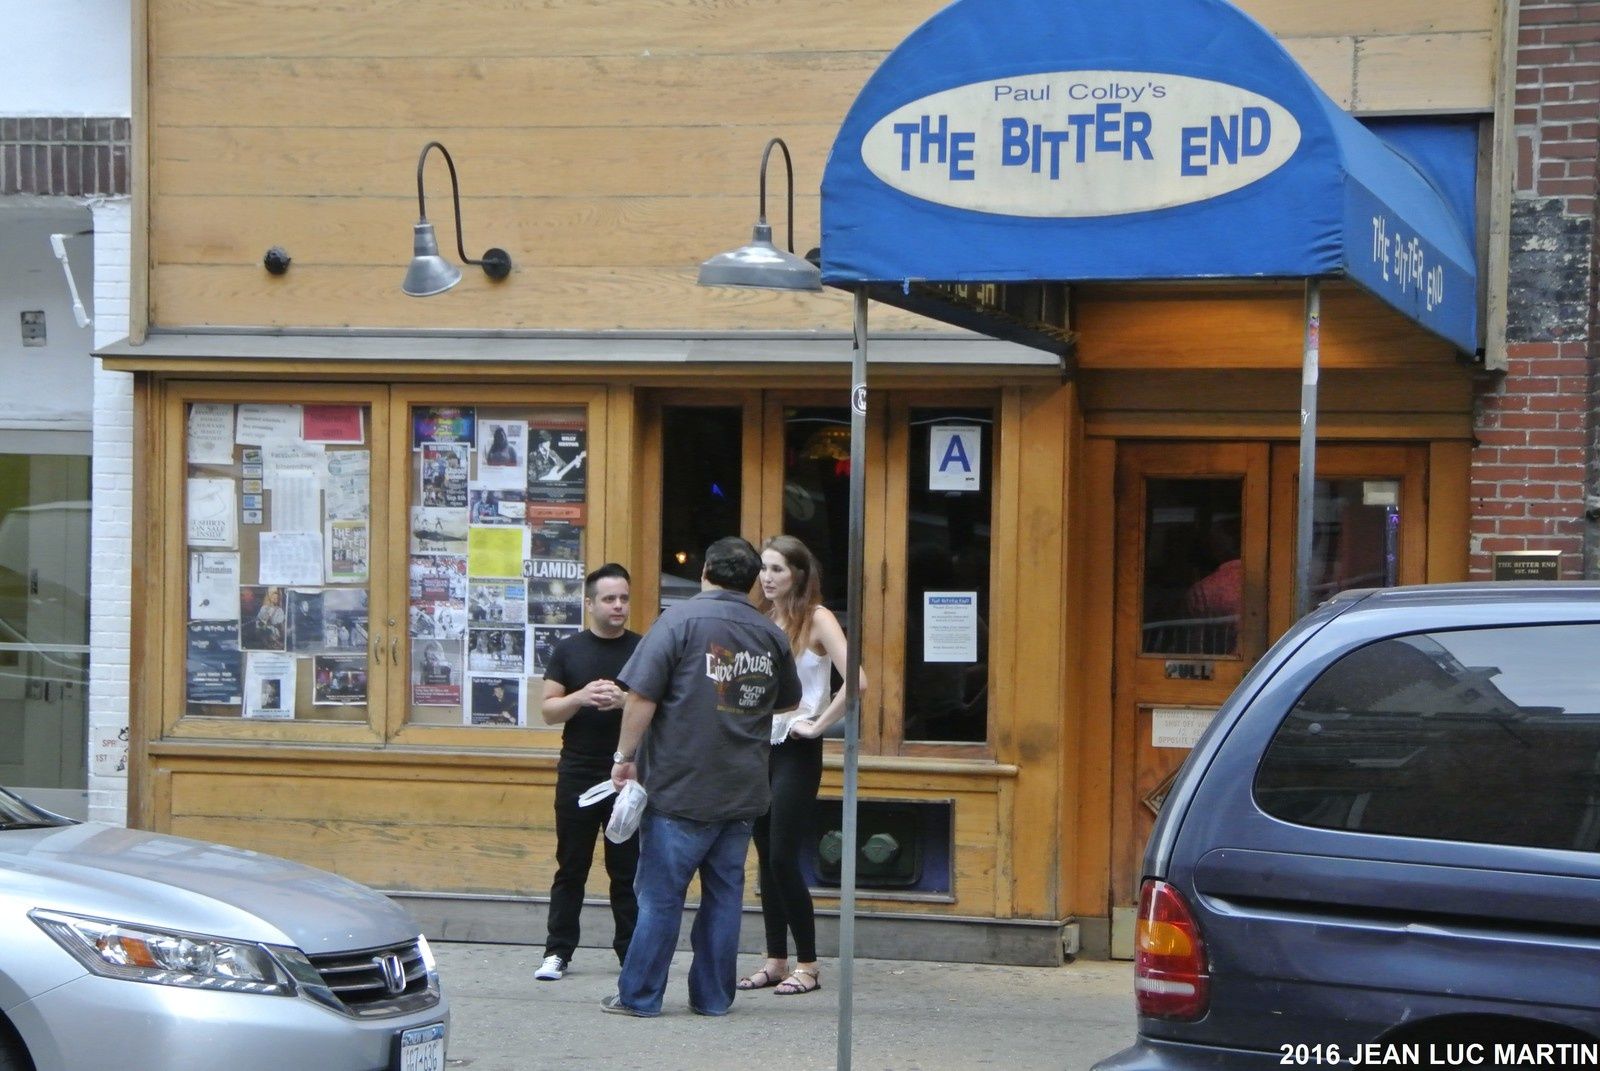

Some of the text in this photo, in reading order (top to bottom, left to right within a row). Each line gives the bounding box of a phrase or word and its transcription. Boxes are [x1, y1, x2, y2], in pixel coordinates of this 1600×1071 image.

[994, 82, 1167, 103] Paul Colby's
[893, 102, 1272, 181] THE BITTER END
[1372, 214, 1443, 312] THE BITTER END
[939, 434, 971, 472] A
[705, 652, 733, 682] Live
